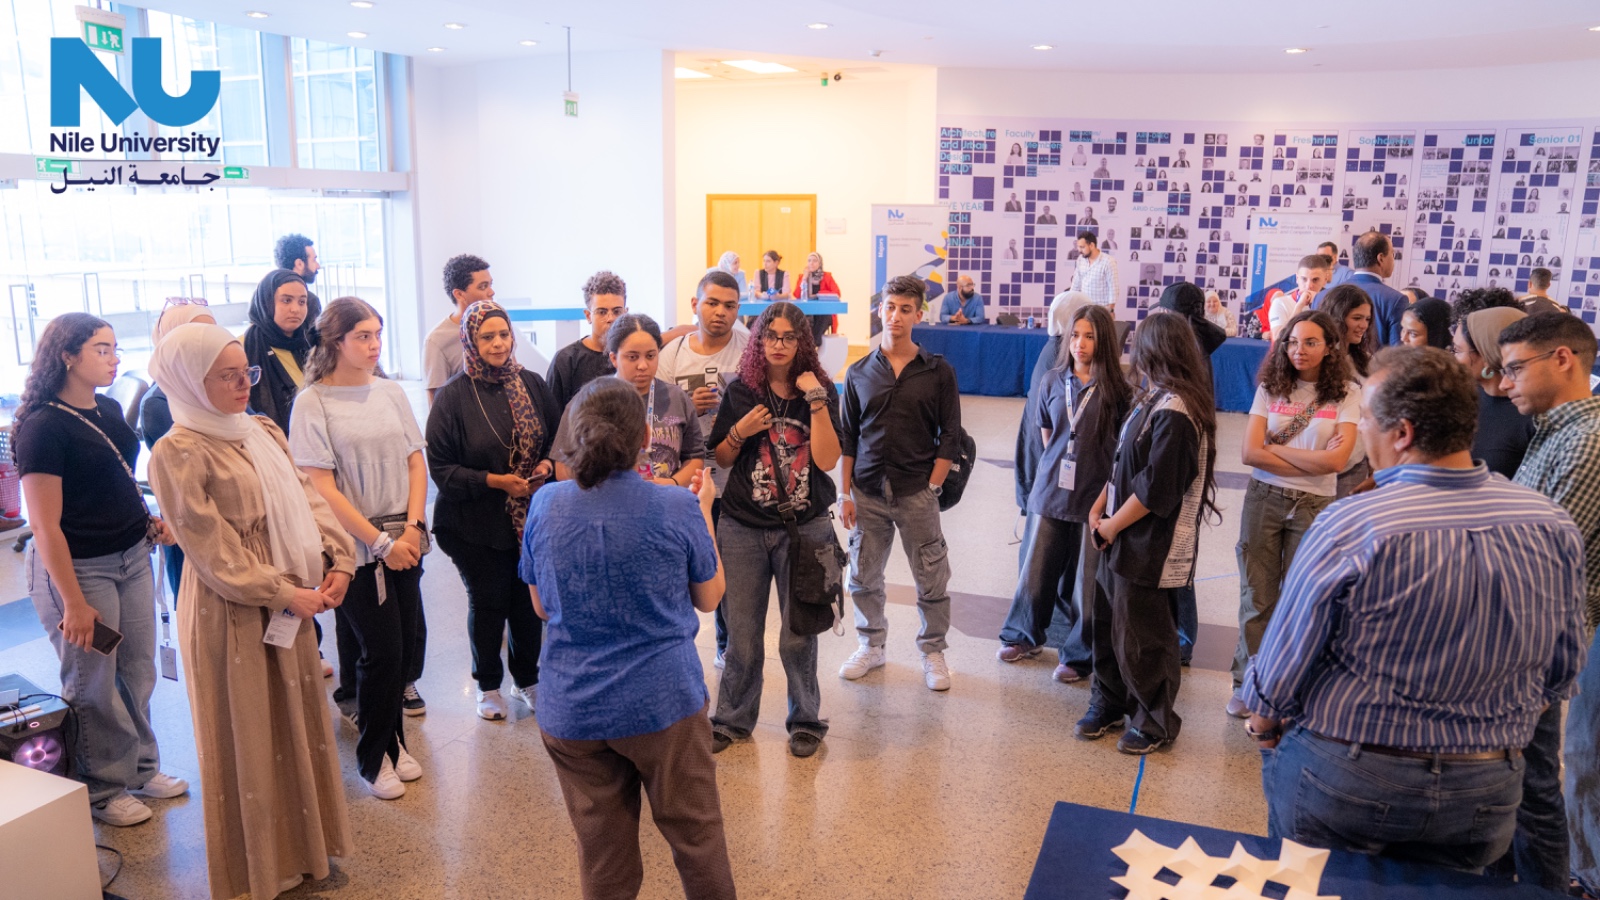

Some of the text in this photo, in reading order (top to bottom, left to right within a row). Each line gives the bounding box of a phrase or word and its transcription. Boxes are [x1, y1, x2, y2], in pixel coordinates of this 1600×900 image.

[940, 128, 996, 138] Architecture
[1005, 129, 1036, 139] Faculty
[1293, 136, 1338, 145] Freshman
[1359, 136, 1415, 146] Sophomore
[1461, 134, 1495, 145] Junior
[1528, 134, 1581, 145] Senior 01
[940, 141, 988, 150] and Urban
[1024, 141, 1063, 149] Members
[940, 152, 971, 162] Design
[888, 209, 905, 219] NU
[1259, 217, 1278, 227] NU
[1255, 246, 1263, 275] Programs
